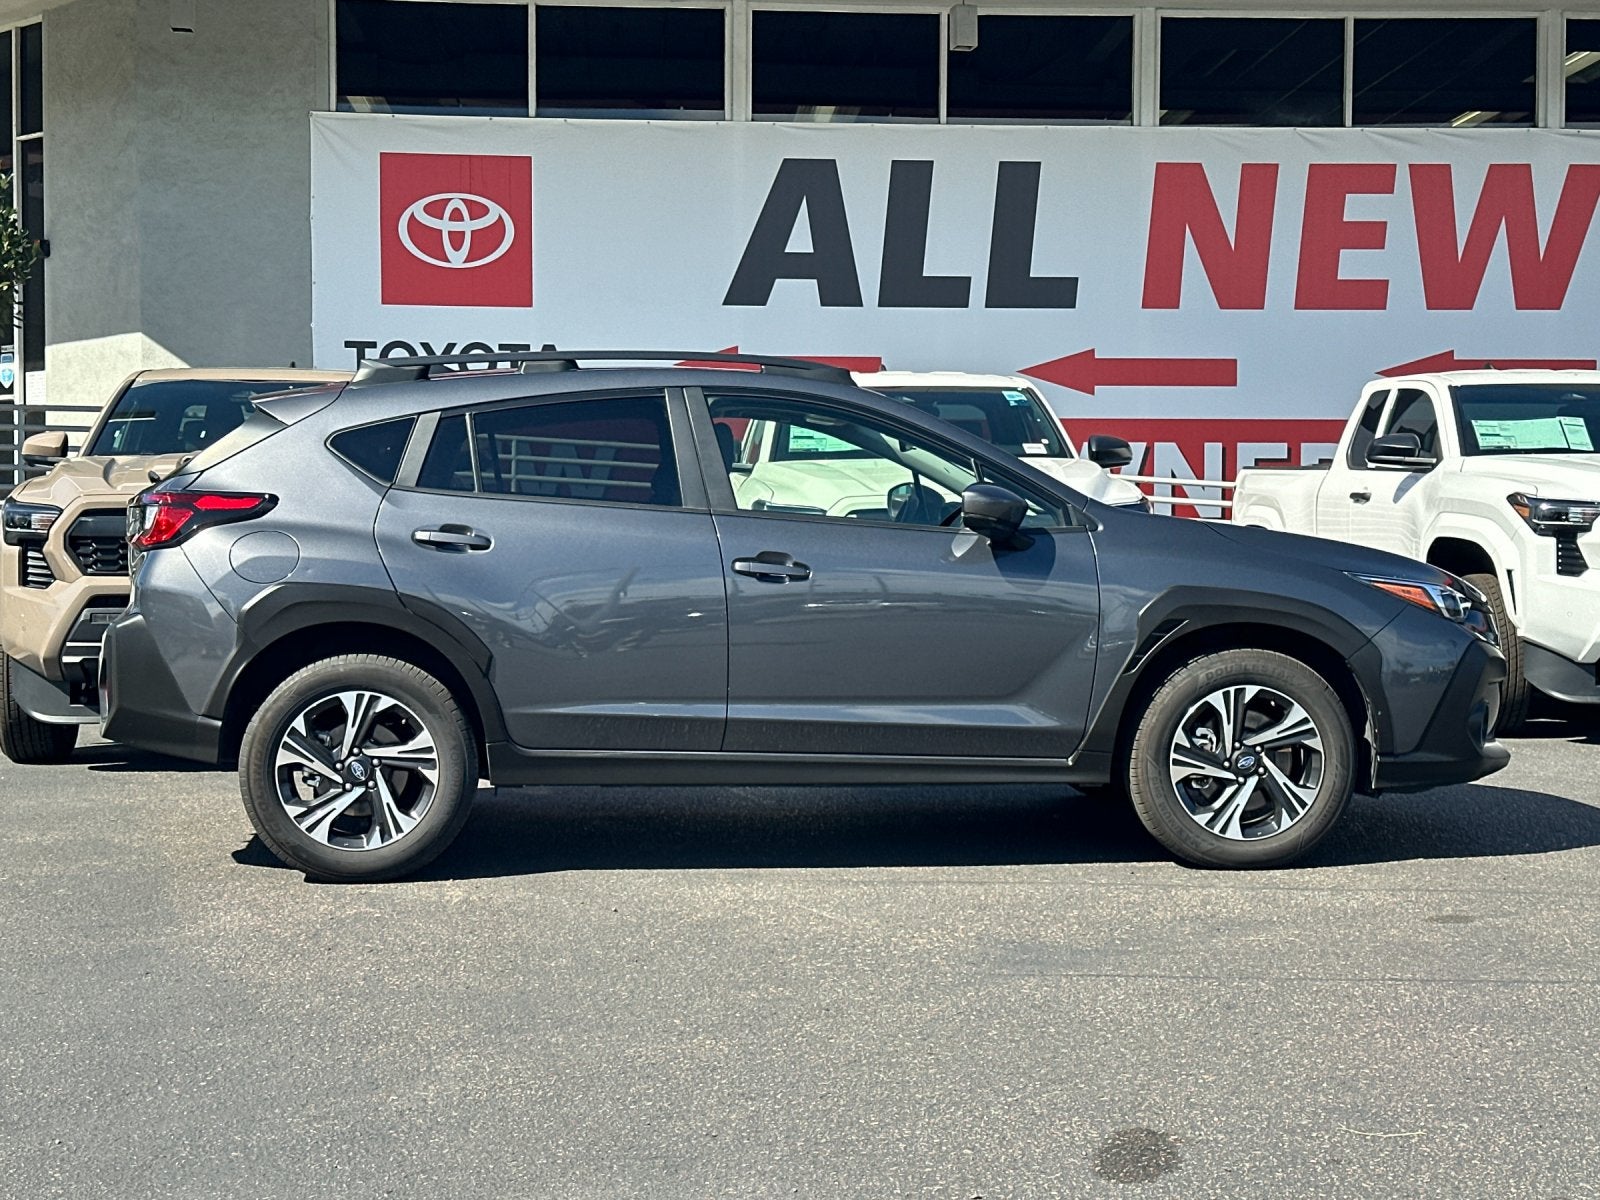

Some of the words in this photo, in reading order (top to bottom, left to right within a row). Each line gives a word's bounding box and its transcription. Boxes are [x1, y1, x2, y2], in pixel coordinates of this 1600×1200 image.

[722, 158, 1079, 309] ALL
[1141, 162, 1600, 311] NEW
[344, 340, 558, 371] TOYOT
